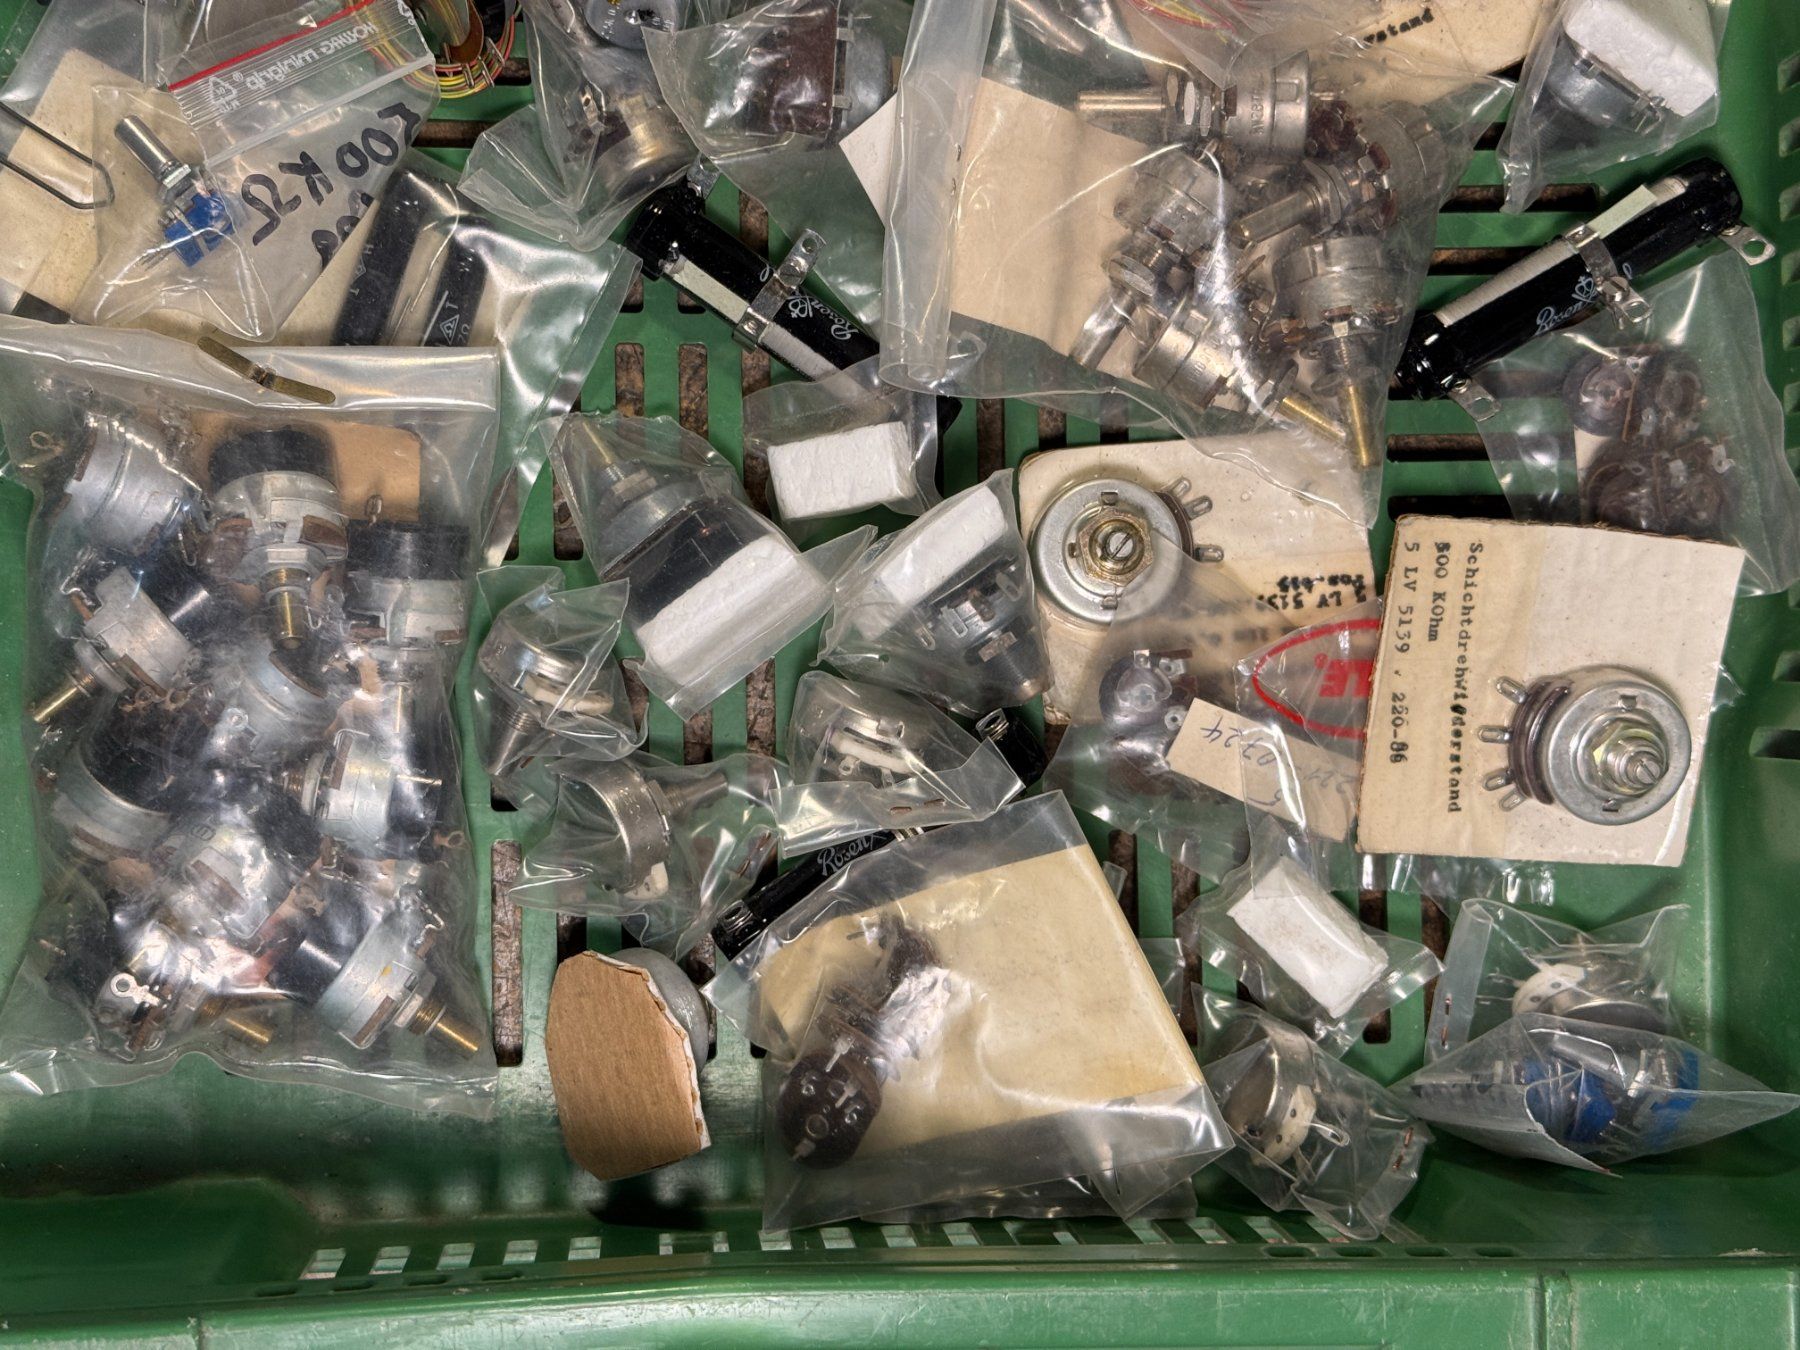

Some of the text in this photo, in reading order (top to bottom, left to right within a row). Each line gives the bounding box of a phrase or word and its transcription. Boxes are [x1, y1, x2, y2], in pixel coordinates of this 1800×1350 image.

[1404, 541, 1421, 552] 5
[1403, 566, 1419, 592] LV
[1394, 605, 1414, 654] 5139
